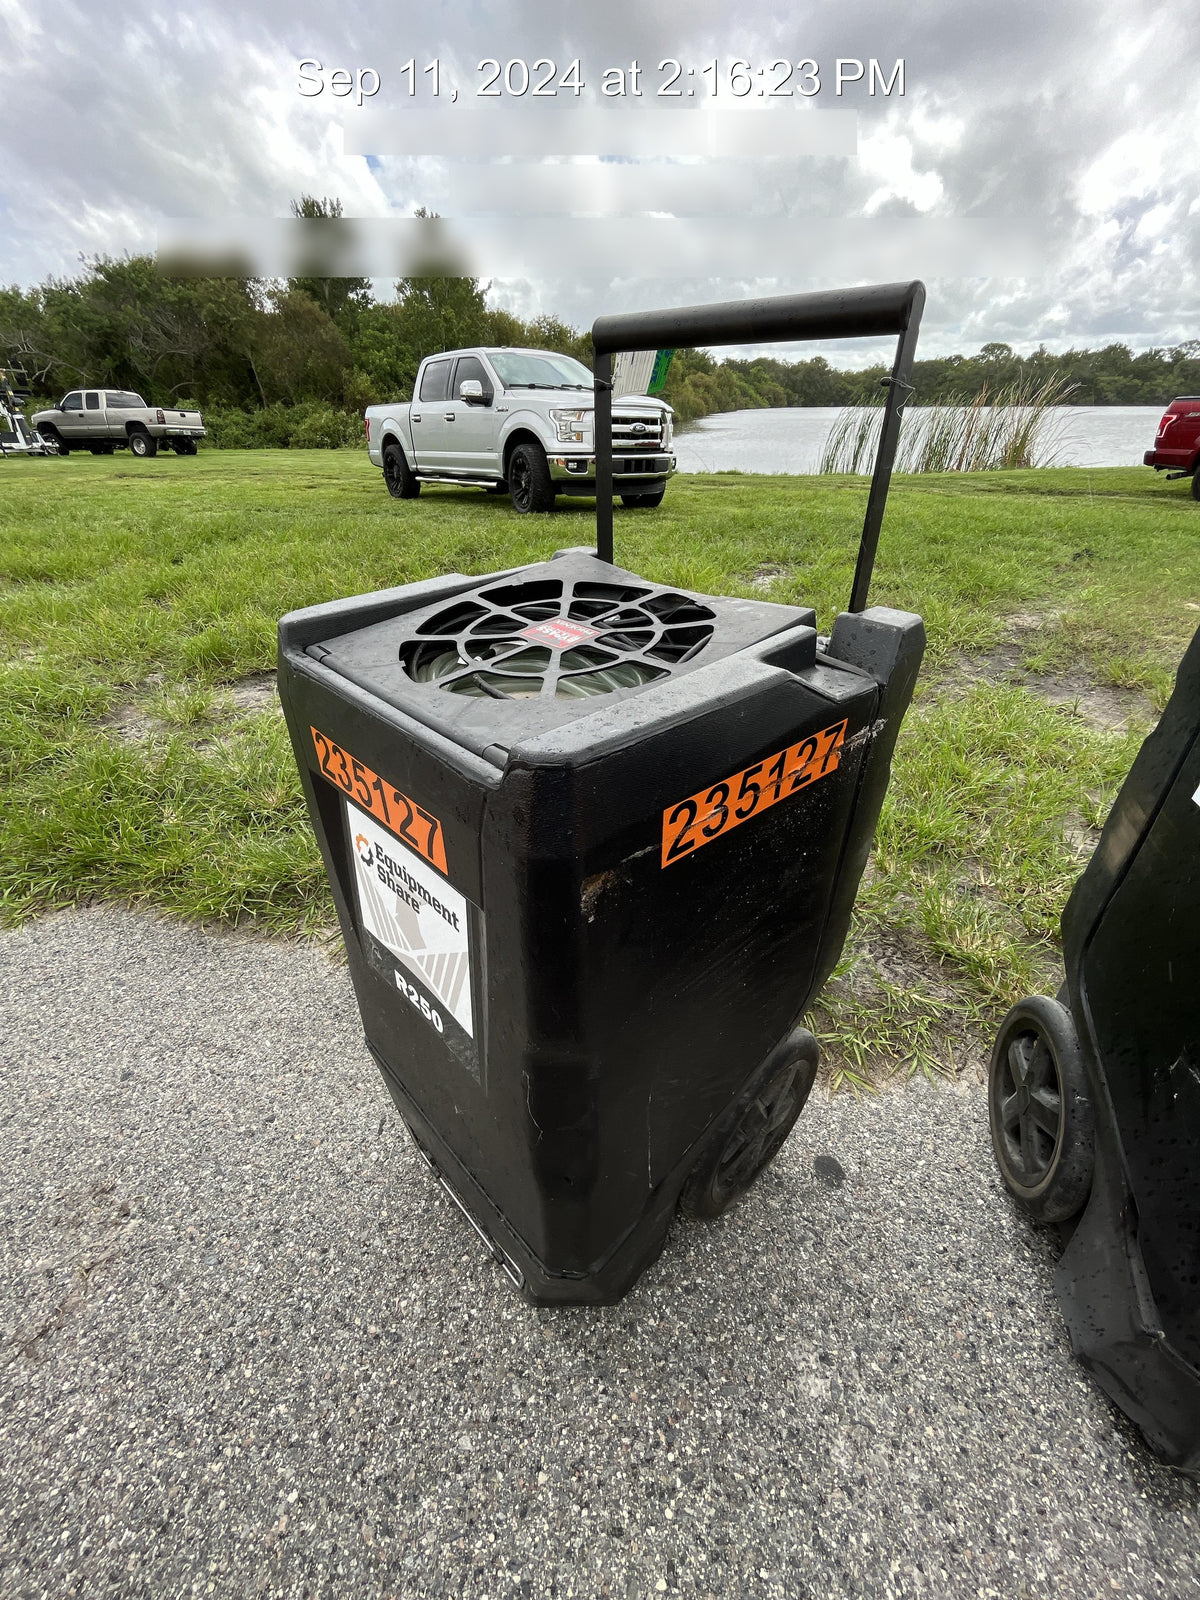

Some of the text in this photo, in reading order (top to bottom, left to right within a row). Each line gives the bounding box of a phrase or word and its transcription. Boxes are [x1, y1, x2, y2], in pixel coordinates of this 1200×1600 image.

[314, 732, 438, 860] 235127
[665, 721, 846, 863] 235127
[373, 842, 461, 933] Equipment
[377, 864, 421, 915] Share
[394, 969, 444, 1034] R250
